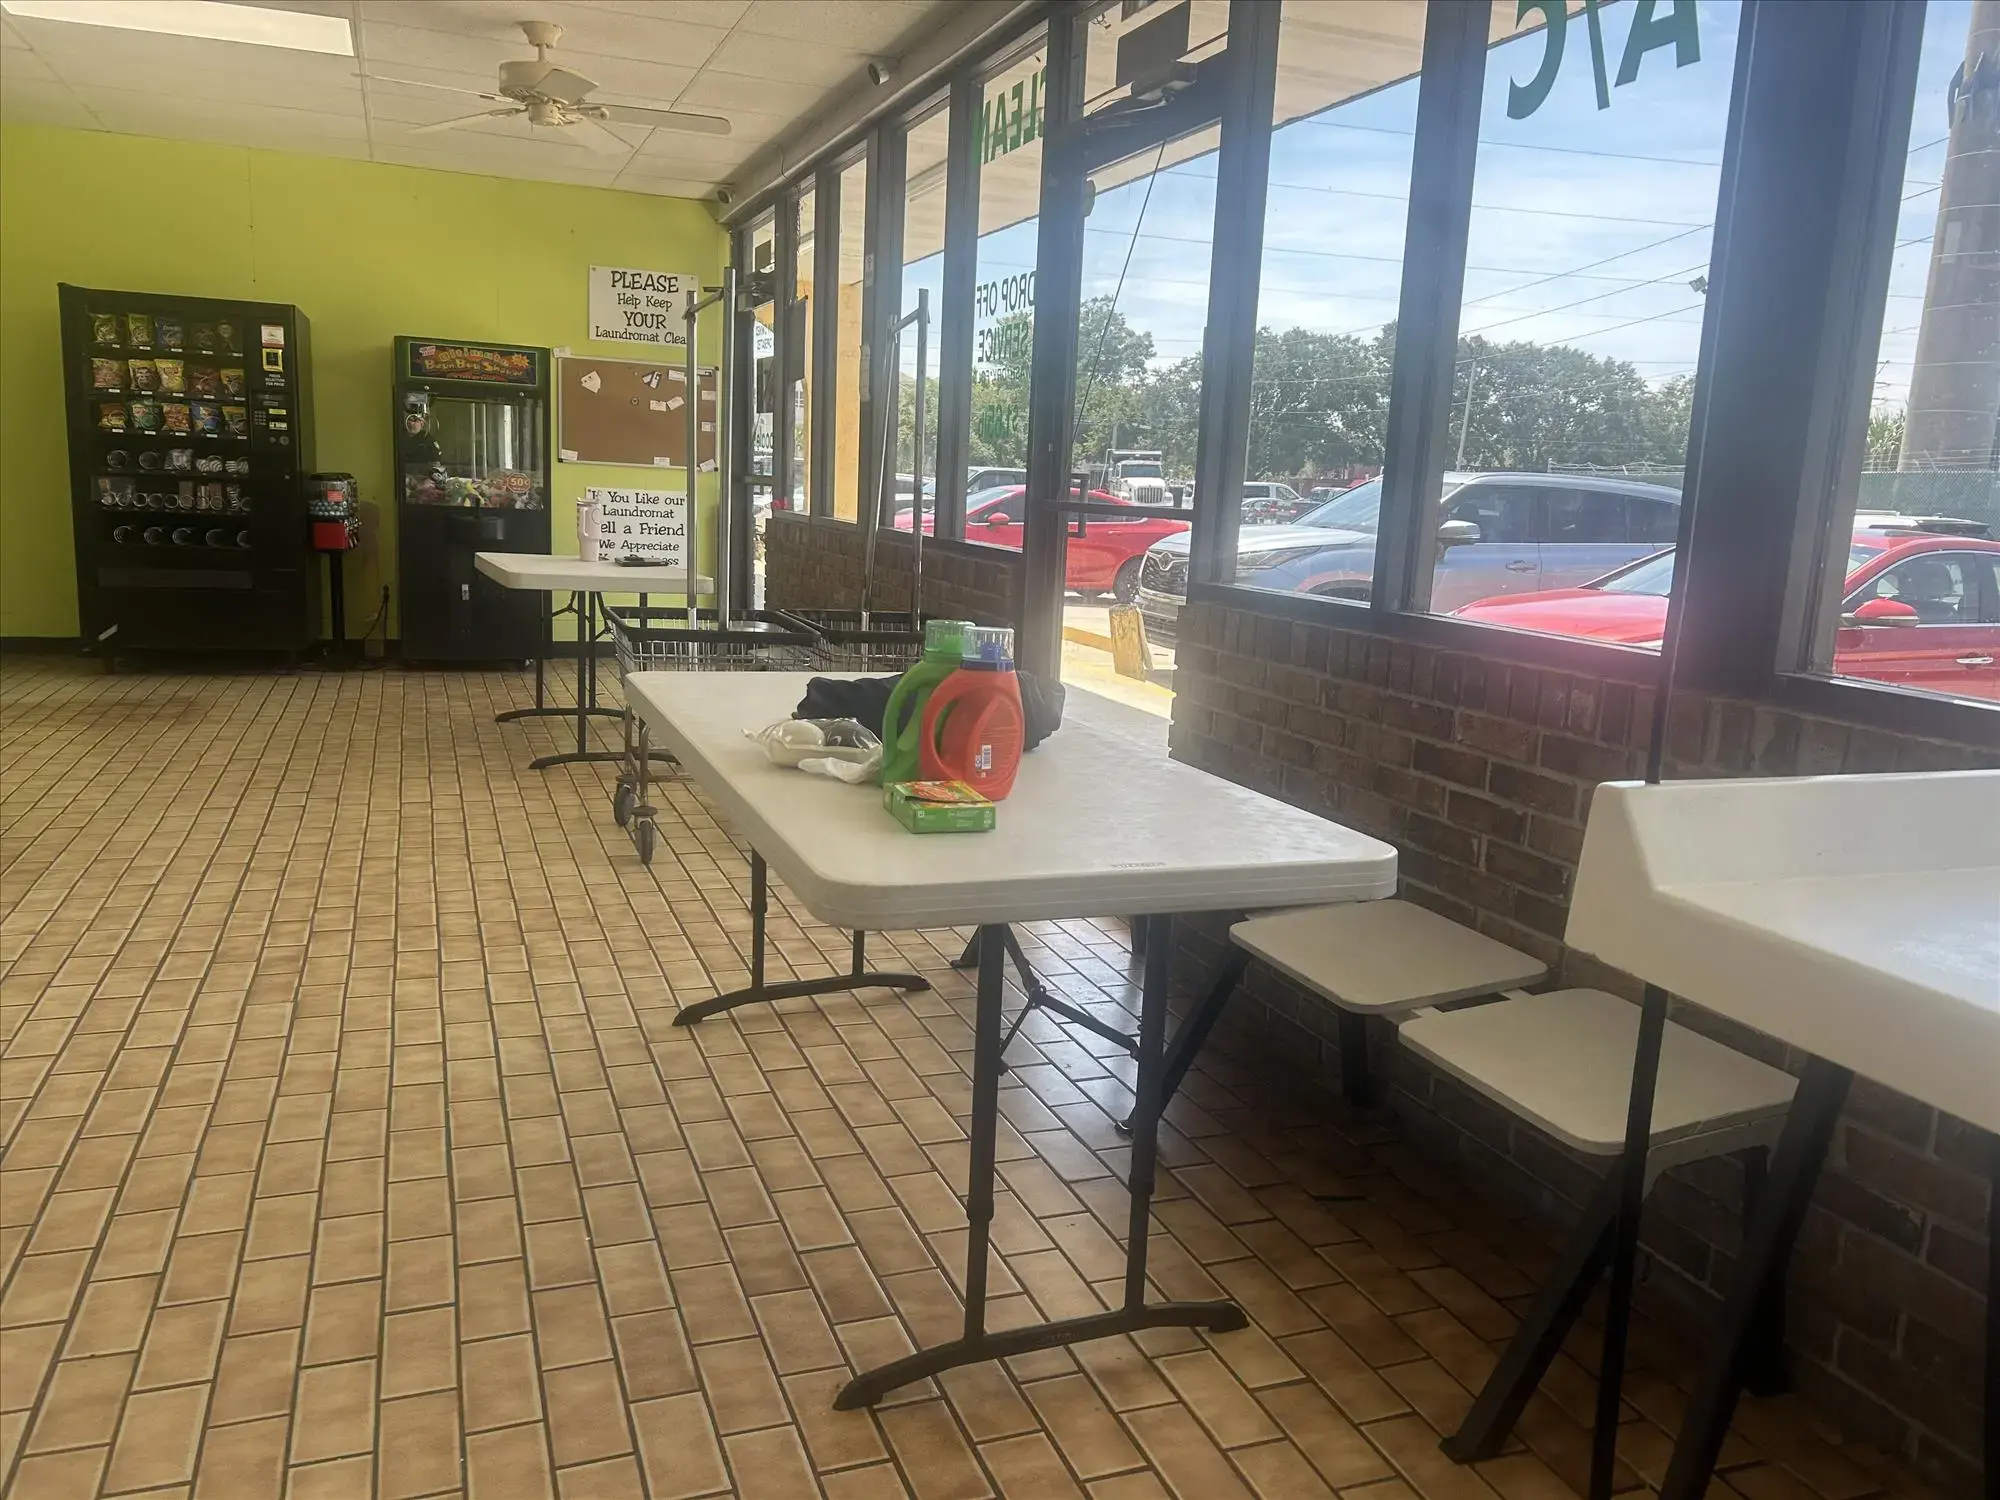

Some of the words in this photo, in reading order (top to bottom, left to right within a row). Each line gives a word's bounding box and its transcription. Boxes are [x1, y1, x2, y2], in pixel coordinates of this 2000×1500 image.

[610, 270, 679, 293] PLEASE
[617, 293, 641, 309] Help
[645, 295, 672, 312] Keep
[623, 310, 667, 329] YOUR
[595, 326, 660, 342] Laundromat
[664, 331, 687, 345] Clea
[608, 491, 630, 503] You
[635, 492, 660, 505] Like
[664, 497, 686, 506] our
[602, 505, 675, 519] Laundromat
[600, 521, 617, 534] ell
[623, 525, 632, 534] a
[639, 522, 686, 537] Friend
[599, 539, 616, 549] We
[620, 540, 680, 552] Appreciate
